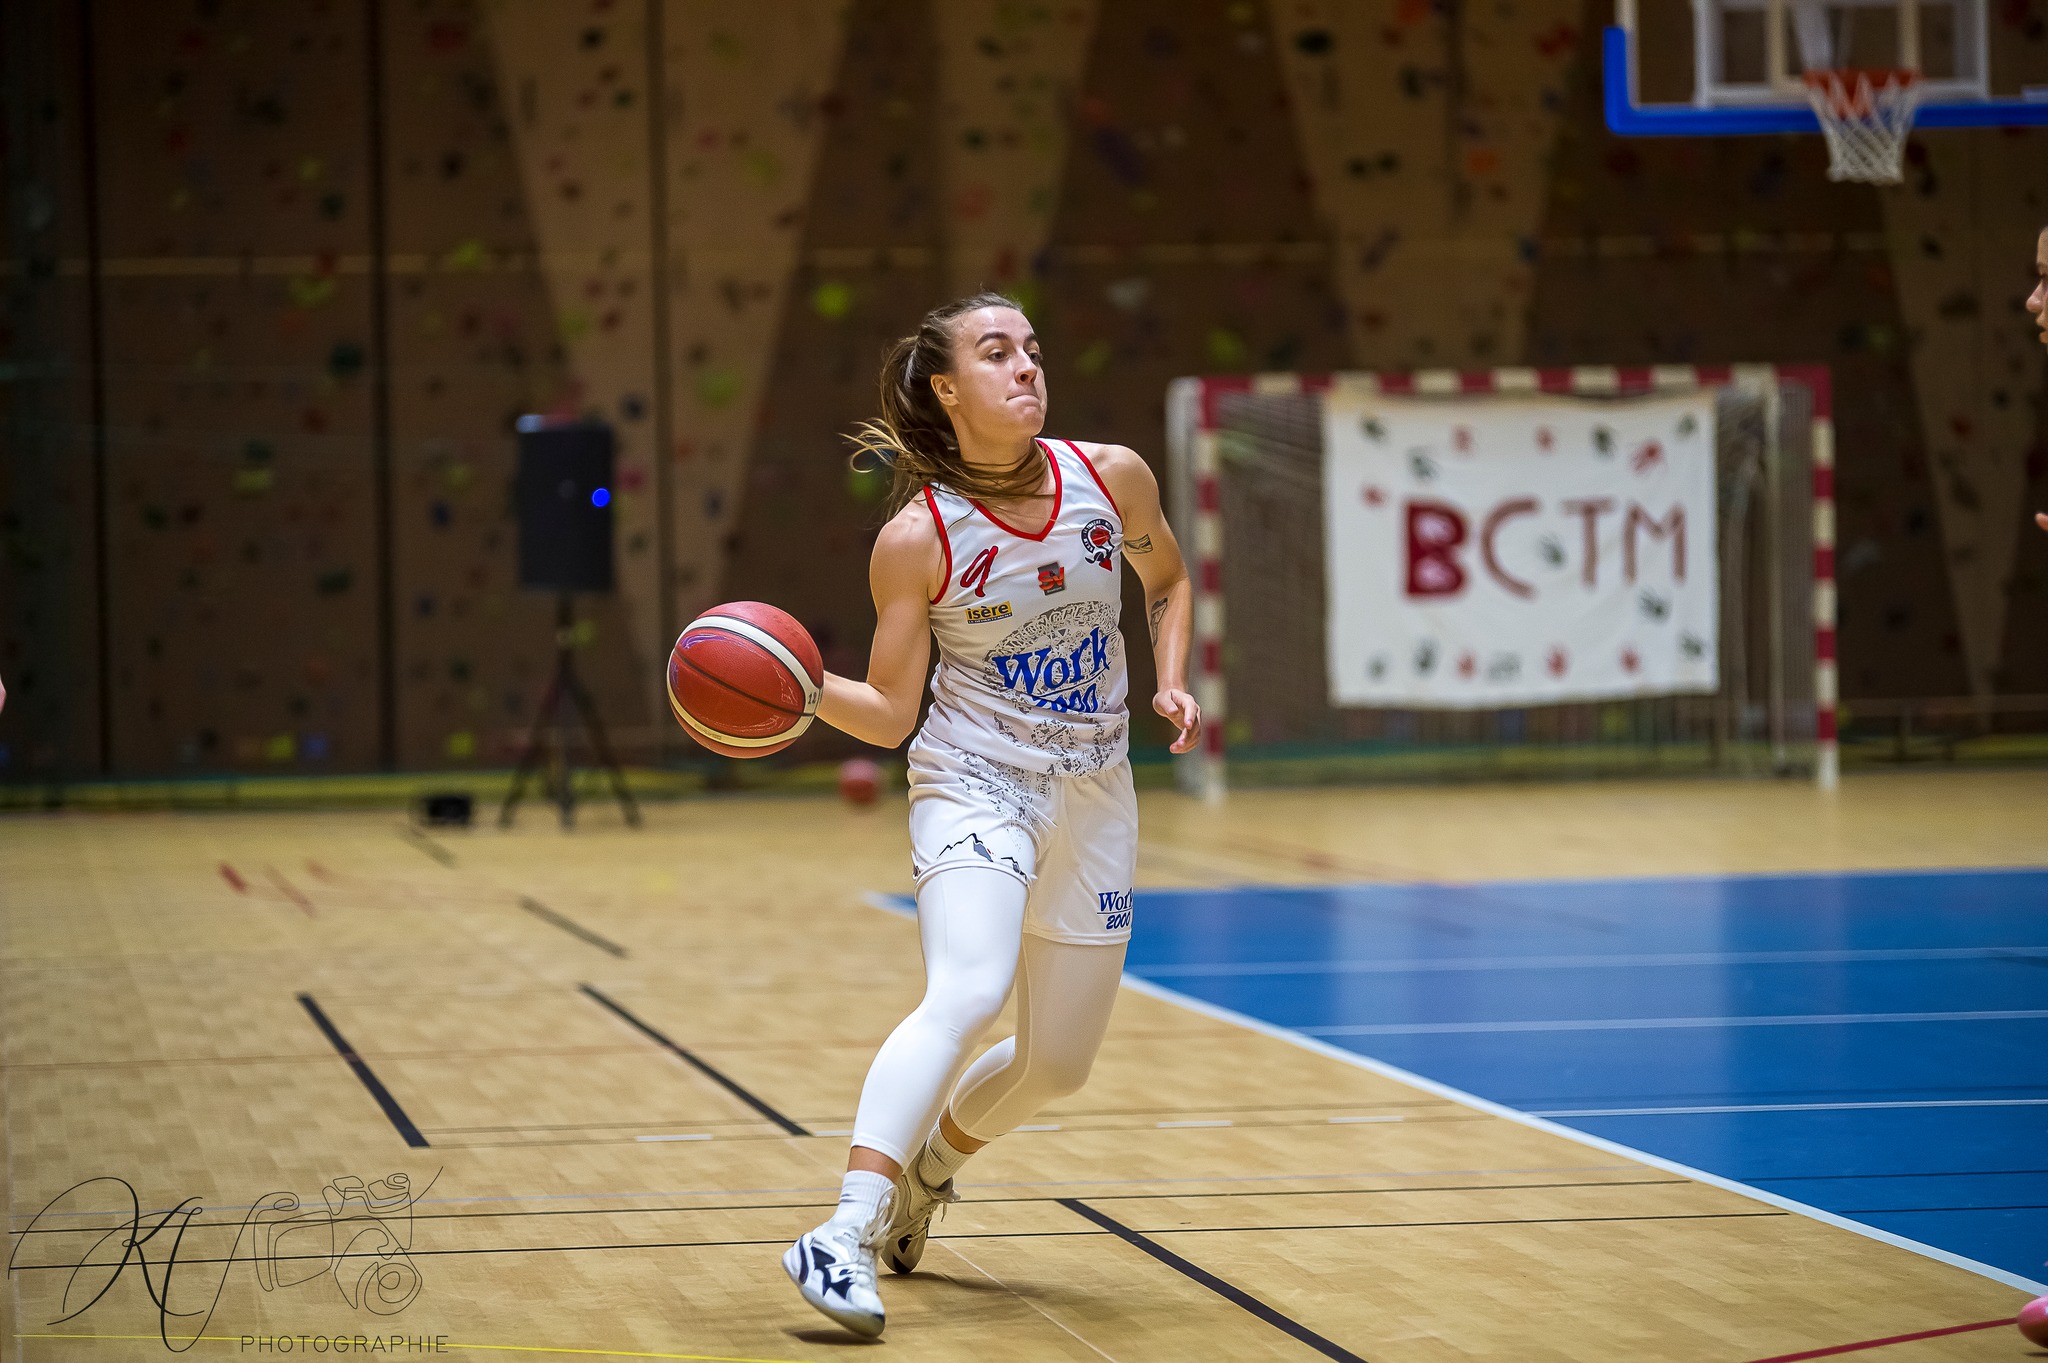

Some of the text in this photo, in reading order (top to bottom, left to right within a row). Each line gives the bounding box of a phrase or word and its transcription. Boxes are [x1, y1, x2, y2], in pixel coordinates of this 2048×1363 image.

[1405, 497, 1687, 600] BCTM
[967, 604, 1009, 620] isère
[991, 626, 1110, 696] Work
